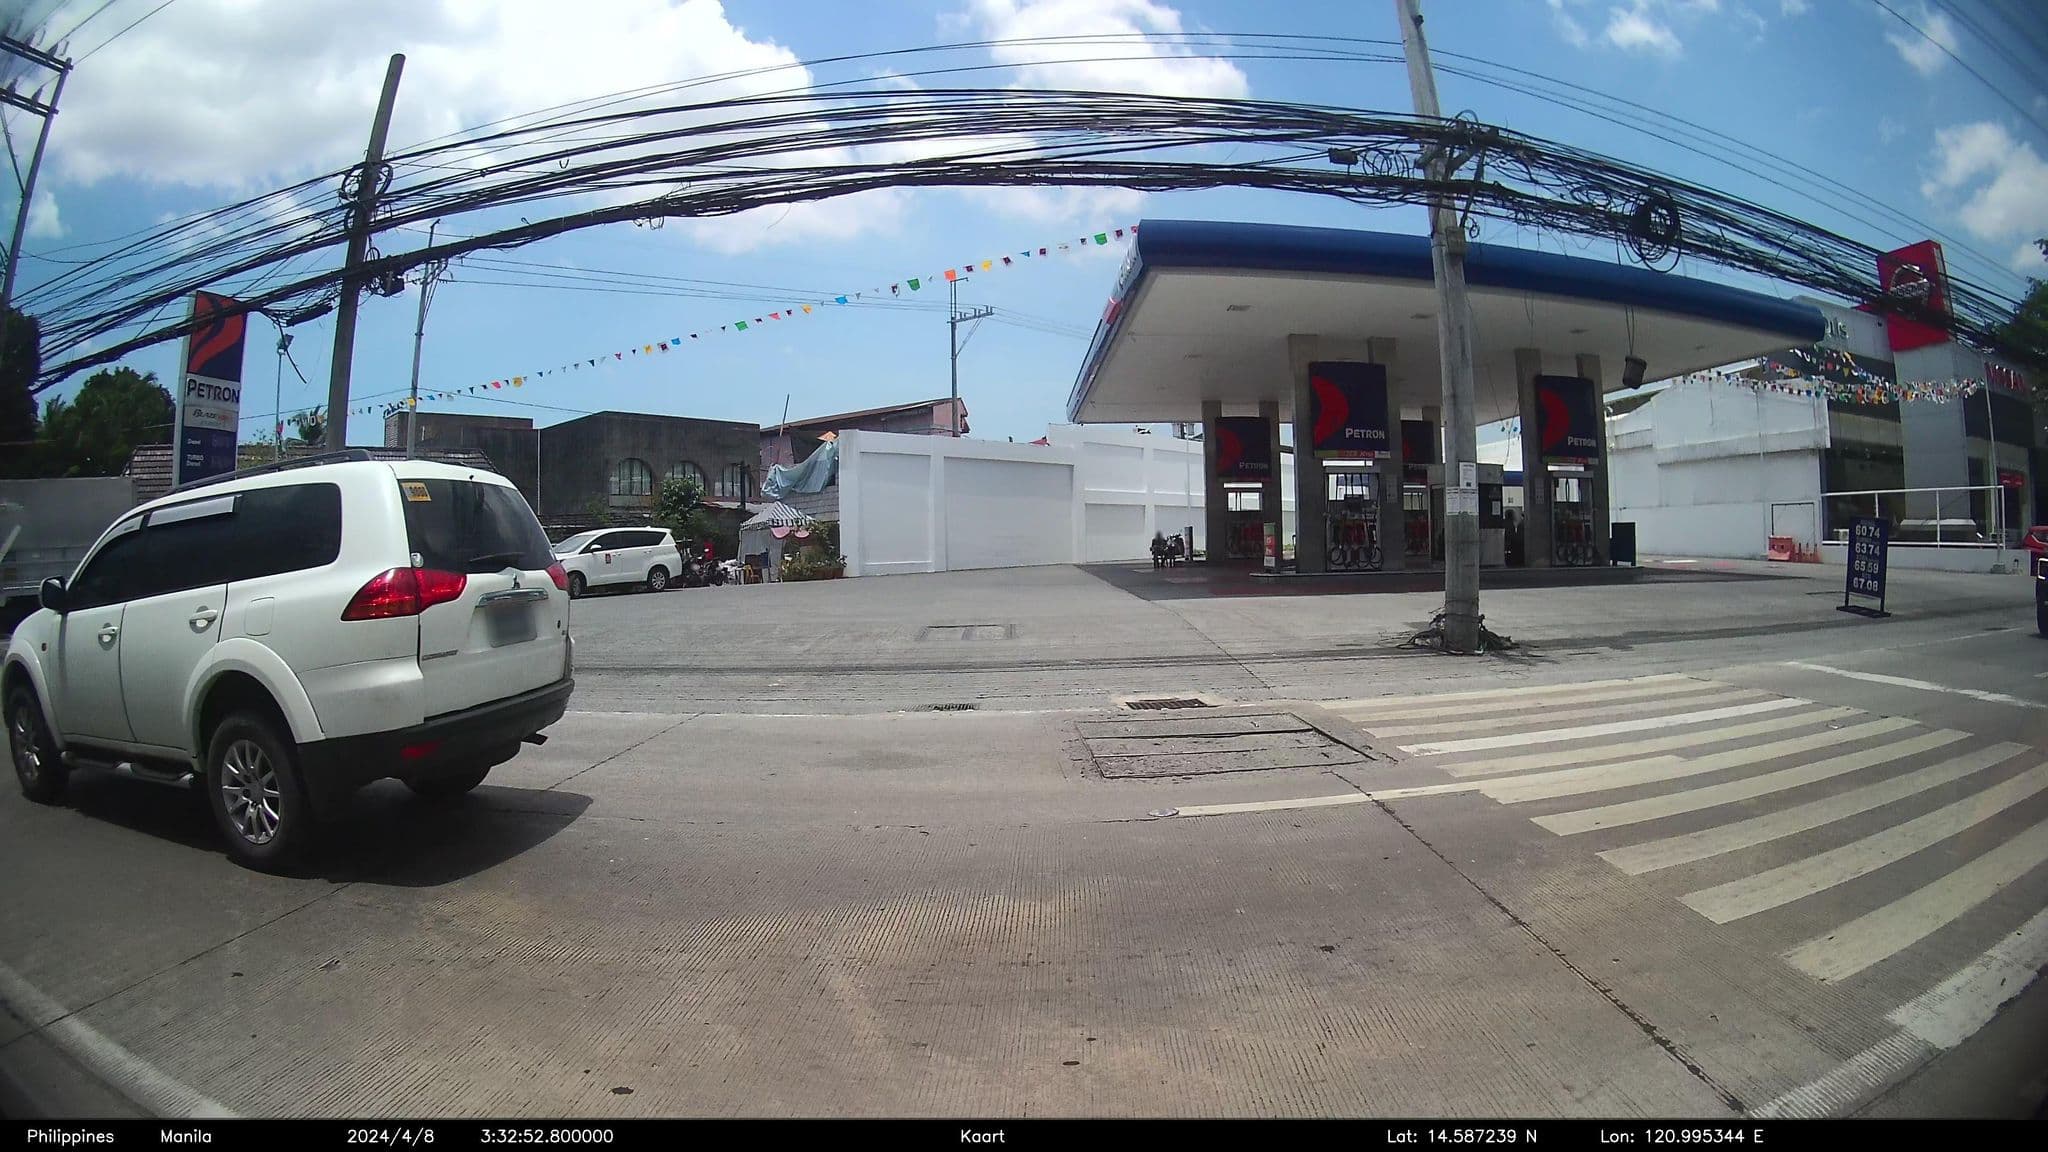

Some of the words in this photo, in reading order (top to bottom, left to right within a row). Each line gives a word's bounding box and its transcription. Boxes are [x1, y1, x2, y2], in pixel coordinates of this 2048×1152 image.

[187, 378, 240, 403] PETRON
[1345, 427, 1385, 440] PETRON
[1567, 436, 1597, 448] PETRON
